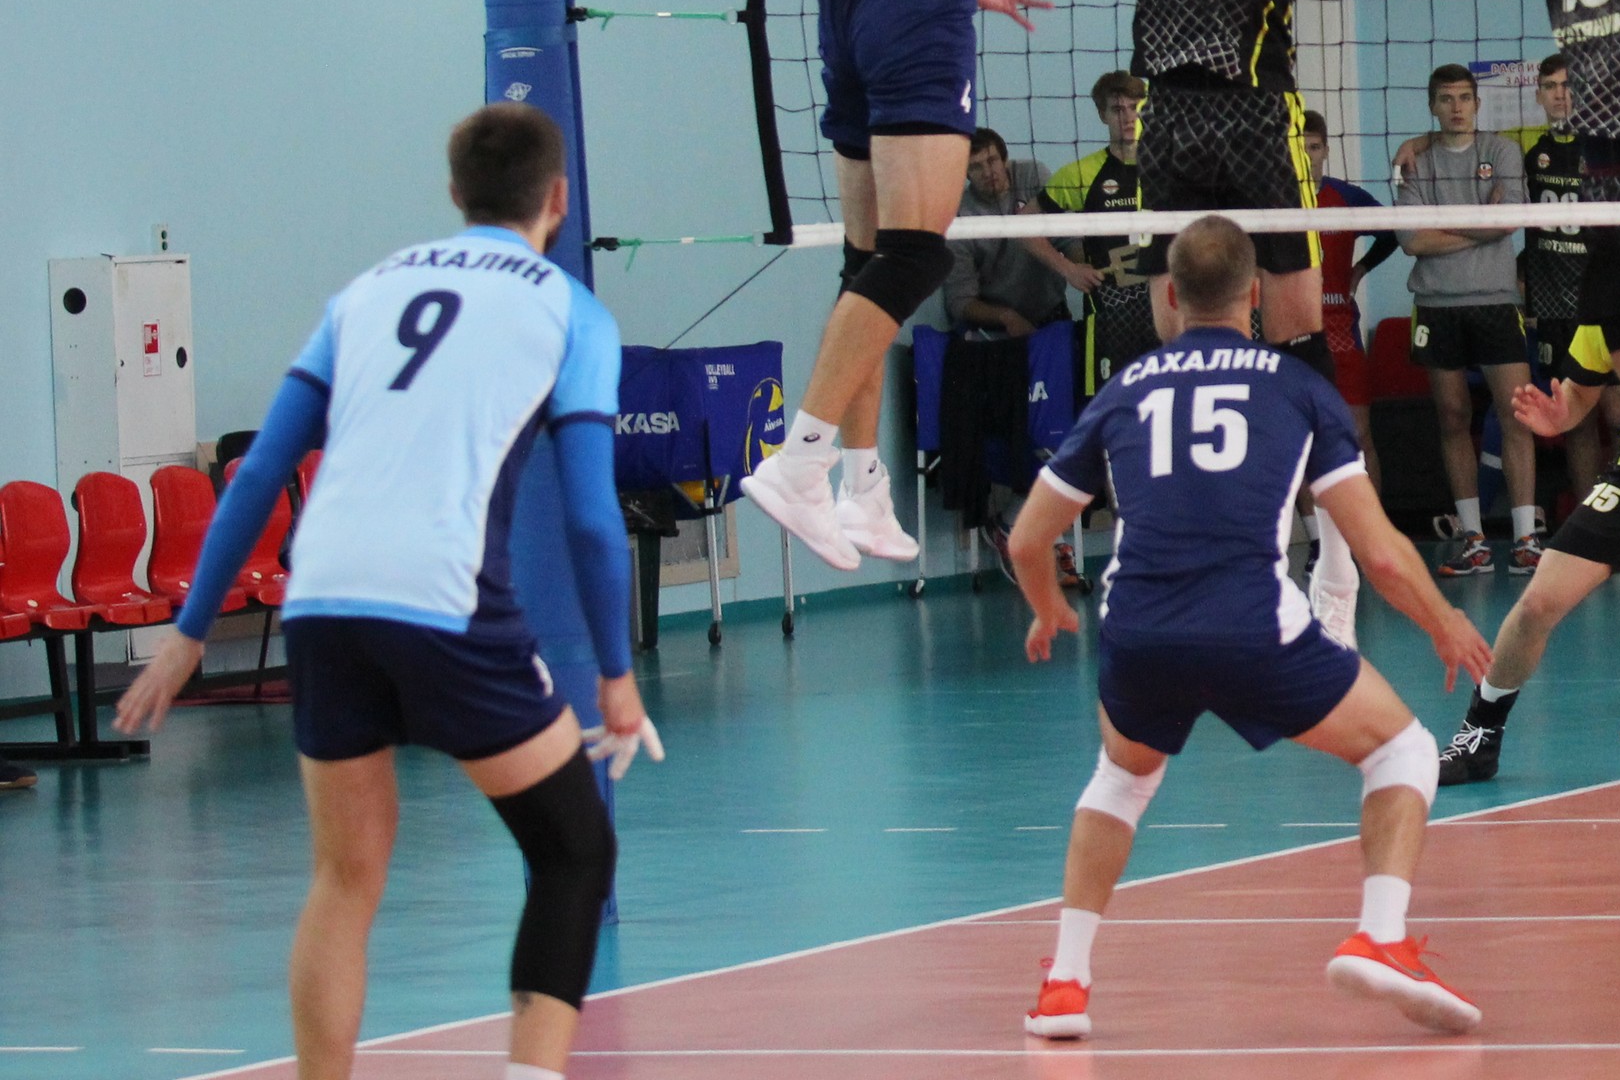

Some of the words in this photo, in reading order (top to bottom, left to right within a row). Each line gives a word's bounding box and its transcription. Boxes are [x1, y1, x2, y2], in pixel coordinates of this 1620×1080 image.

[386, 287, 464, 392] 9
[1414, 324, 1430, 348] 6
[1121, 348, 1281, 387] САХАЛИН
[615, 411, 680, 435] KASA
[1137, 384, 1250, 478] 15
